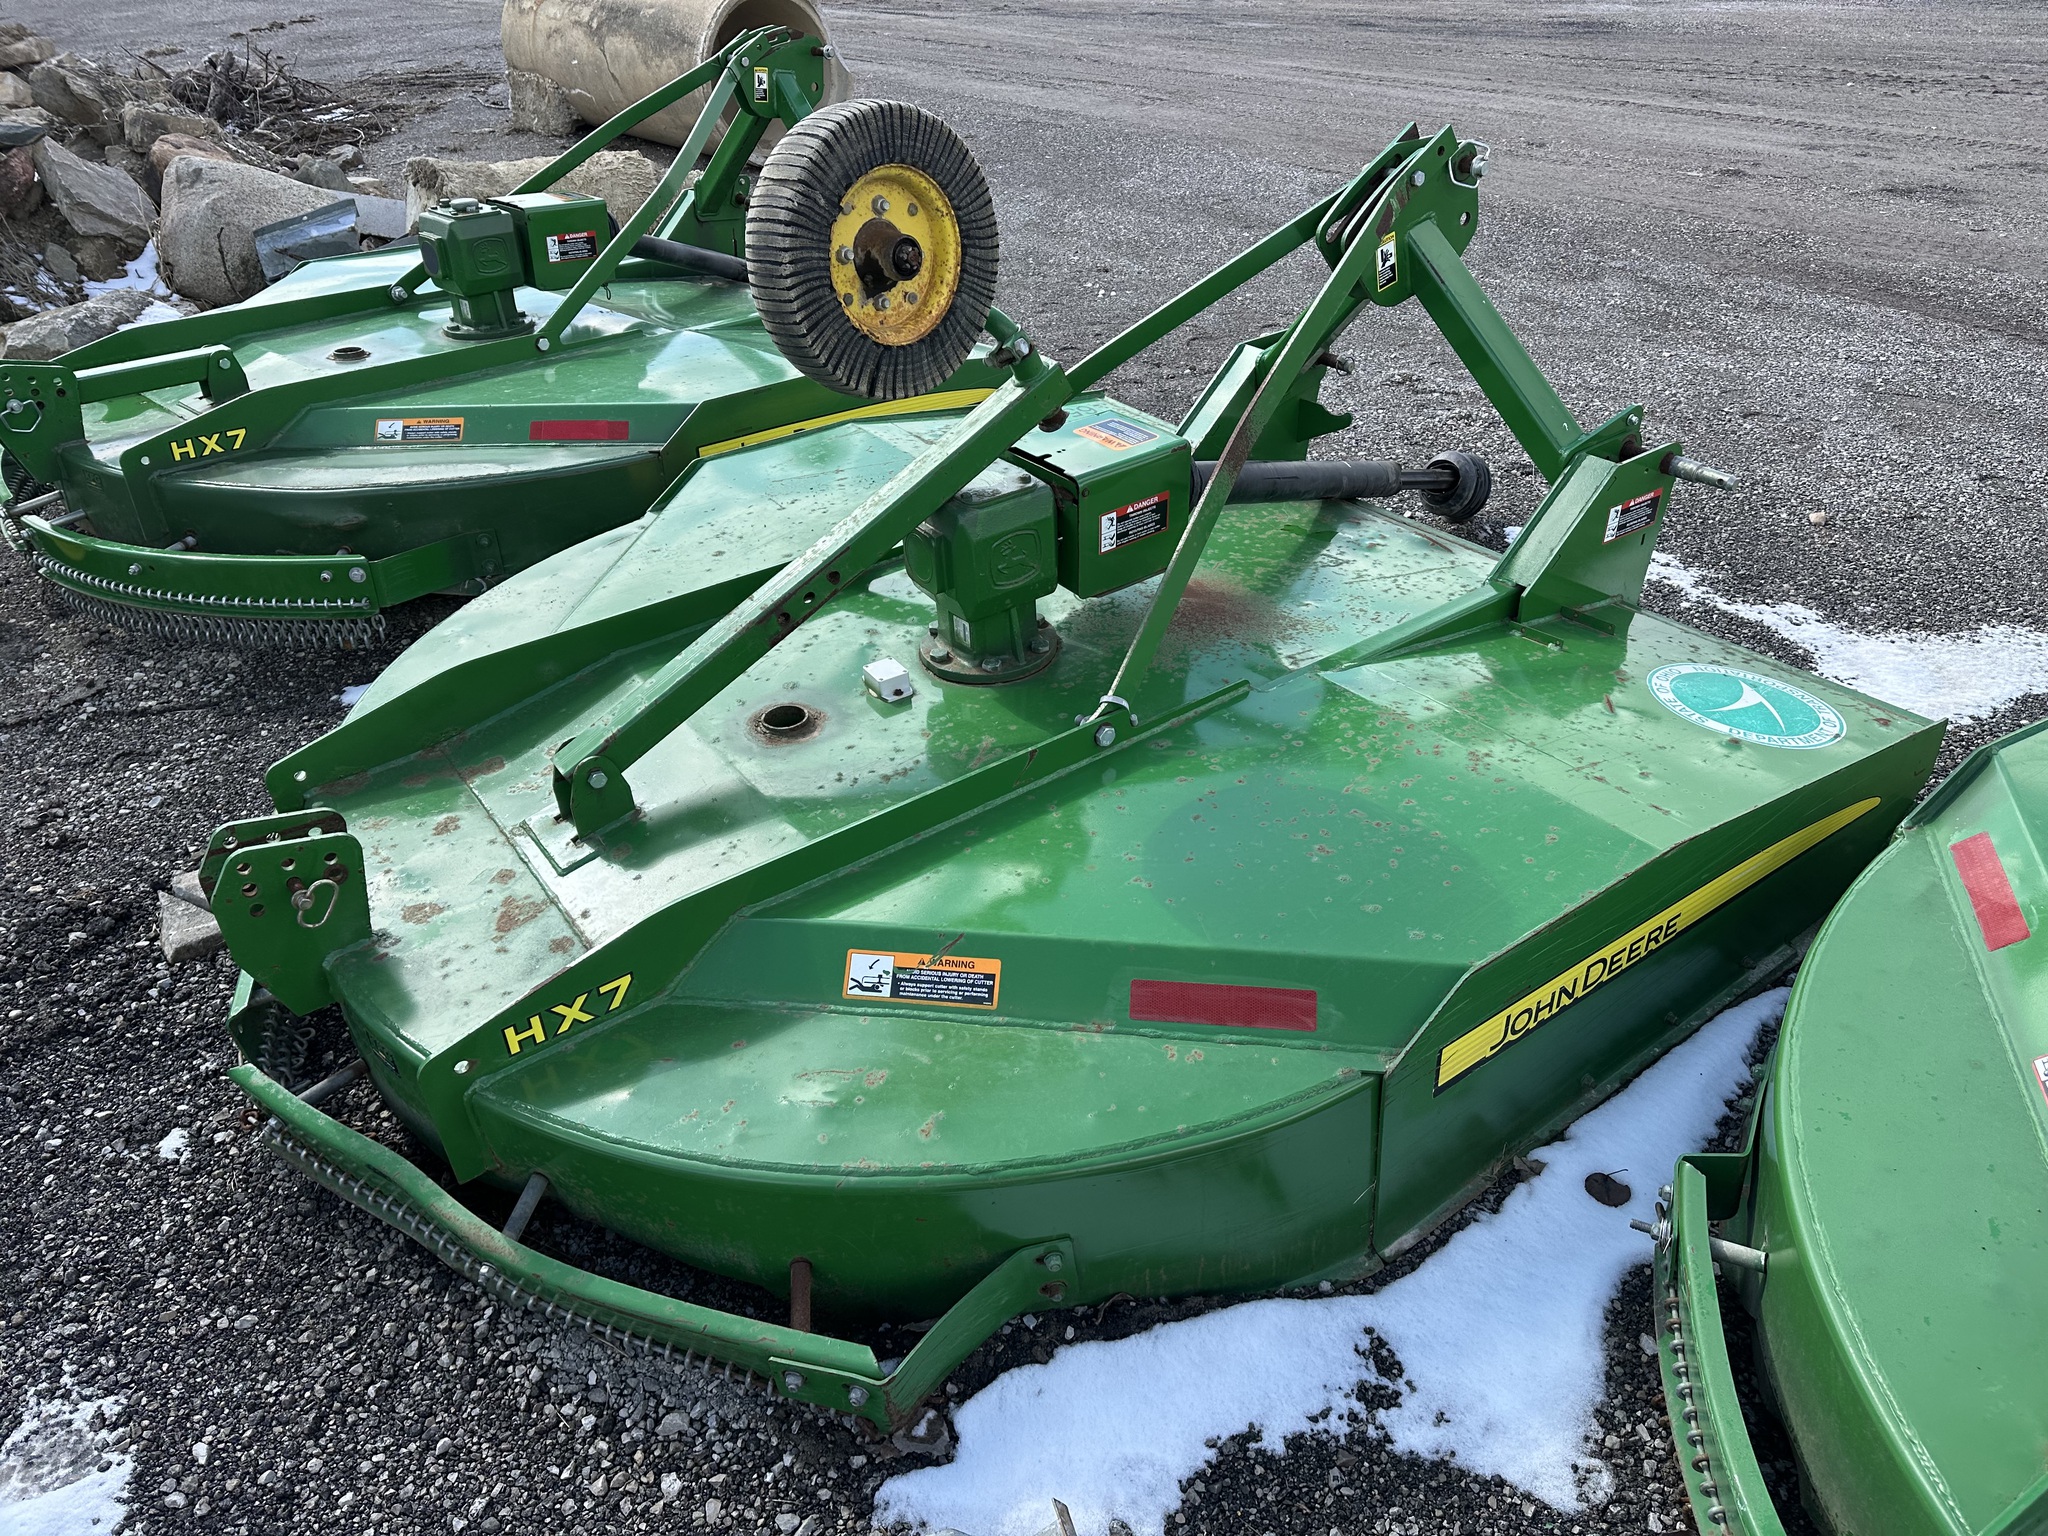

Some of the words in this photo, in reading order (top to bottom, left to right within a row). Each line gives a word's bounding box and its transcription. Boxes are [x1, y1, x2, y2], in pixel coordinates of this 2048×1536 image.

[170, 427, 247, 462] HX7
[1133, 496, 1159, 510] DANGER
[1635, 492, 1655, 504] DANGER
[1656, 668, 1682, 681] OHIO
[1655, 683, 1670, 694] OF
[1663, 697, 1709, 723] STATE
[1728, 727, 1834, 745] DEPARTMENT
[1821, 716, 1837, 728] OF
[1489, 977, 1579, 1052] JOHN
[1581, 912, 1682, 992] DEERE
[502, 972, 633, 1056] HX7
